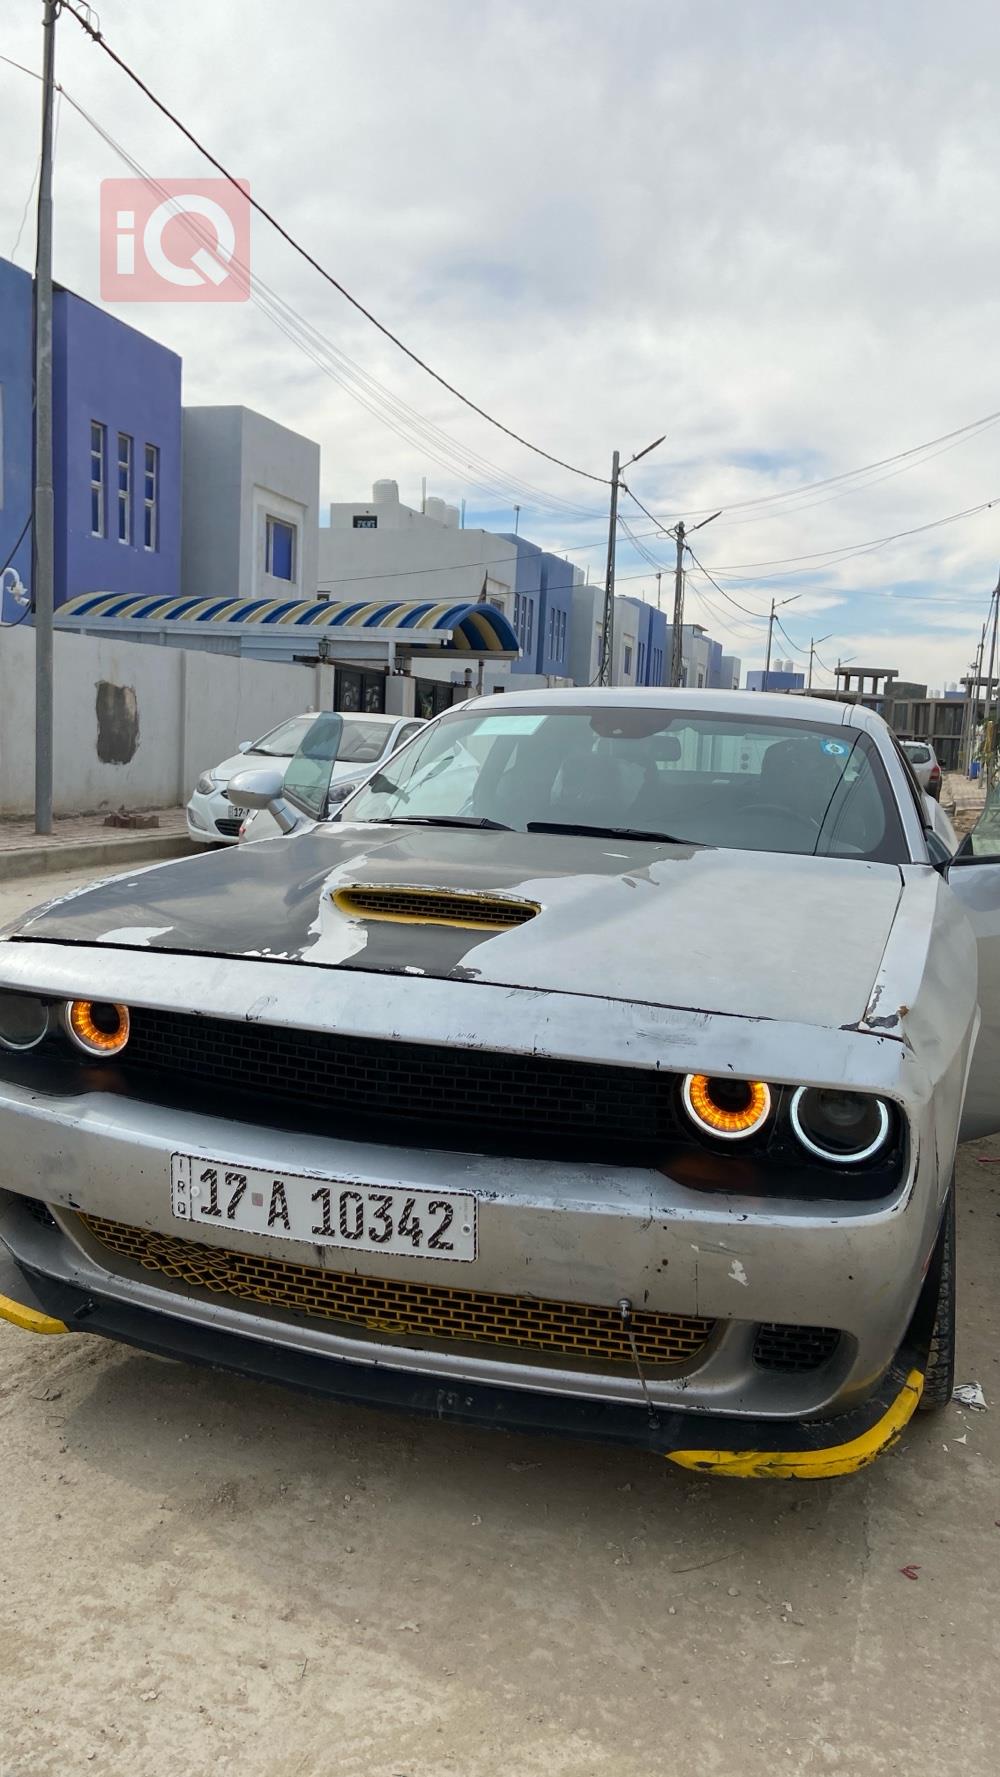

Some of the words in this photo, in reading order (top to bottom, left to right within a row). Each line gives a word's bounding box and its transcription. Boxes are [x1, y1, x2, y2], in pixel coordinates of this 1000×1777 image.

[200, 1168, 247, 1219] 17
[267, 1180, 291, 1230] A
[311, 1187, 454, 1251] 10342
